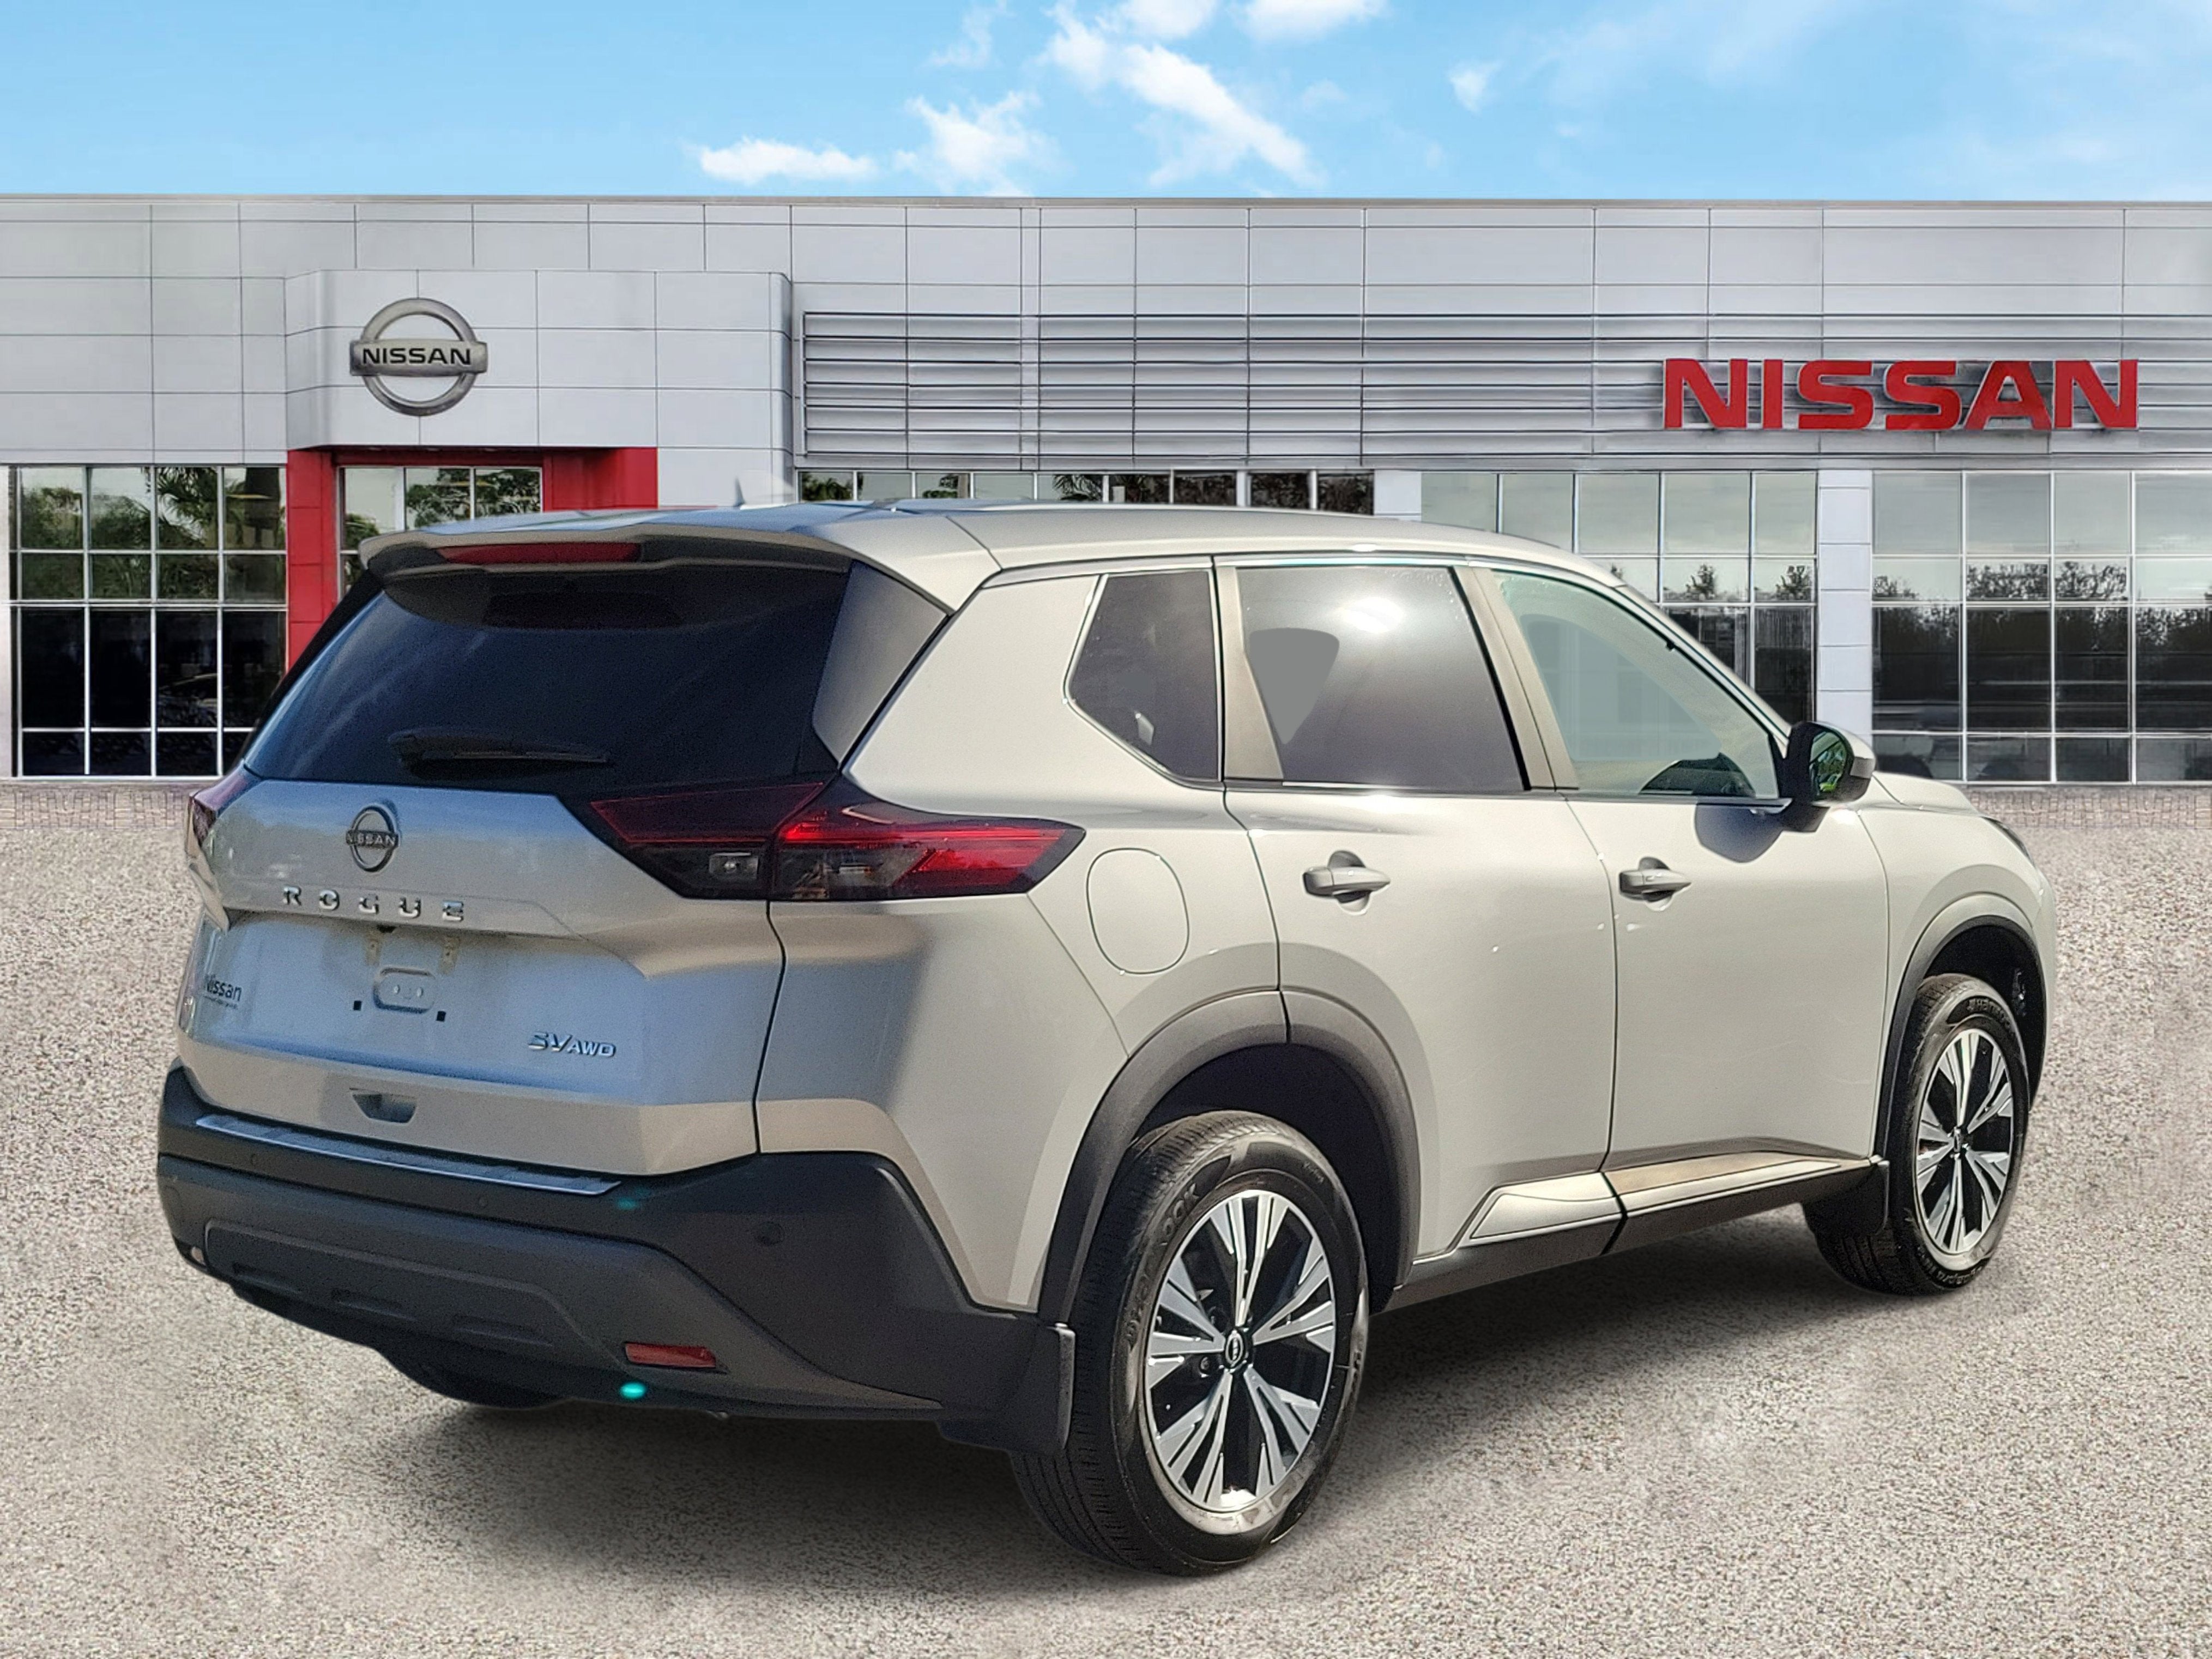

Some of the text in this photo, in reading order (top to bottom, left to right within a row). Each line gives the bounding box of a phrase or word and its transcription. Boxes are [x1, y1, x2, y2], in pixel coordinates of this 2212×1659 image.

[362, 348, 470, 365] NISSAN
[1663, 358, 2139, 430] NISSAN
[283, 885, 464, 922] ROGUE
[528, 1032, 617, 1057] SV AWD
